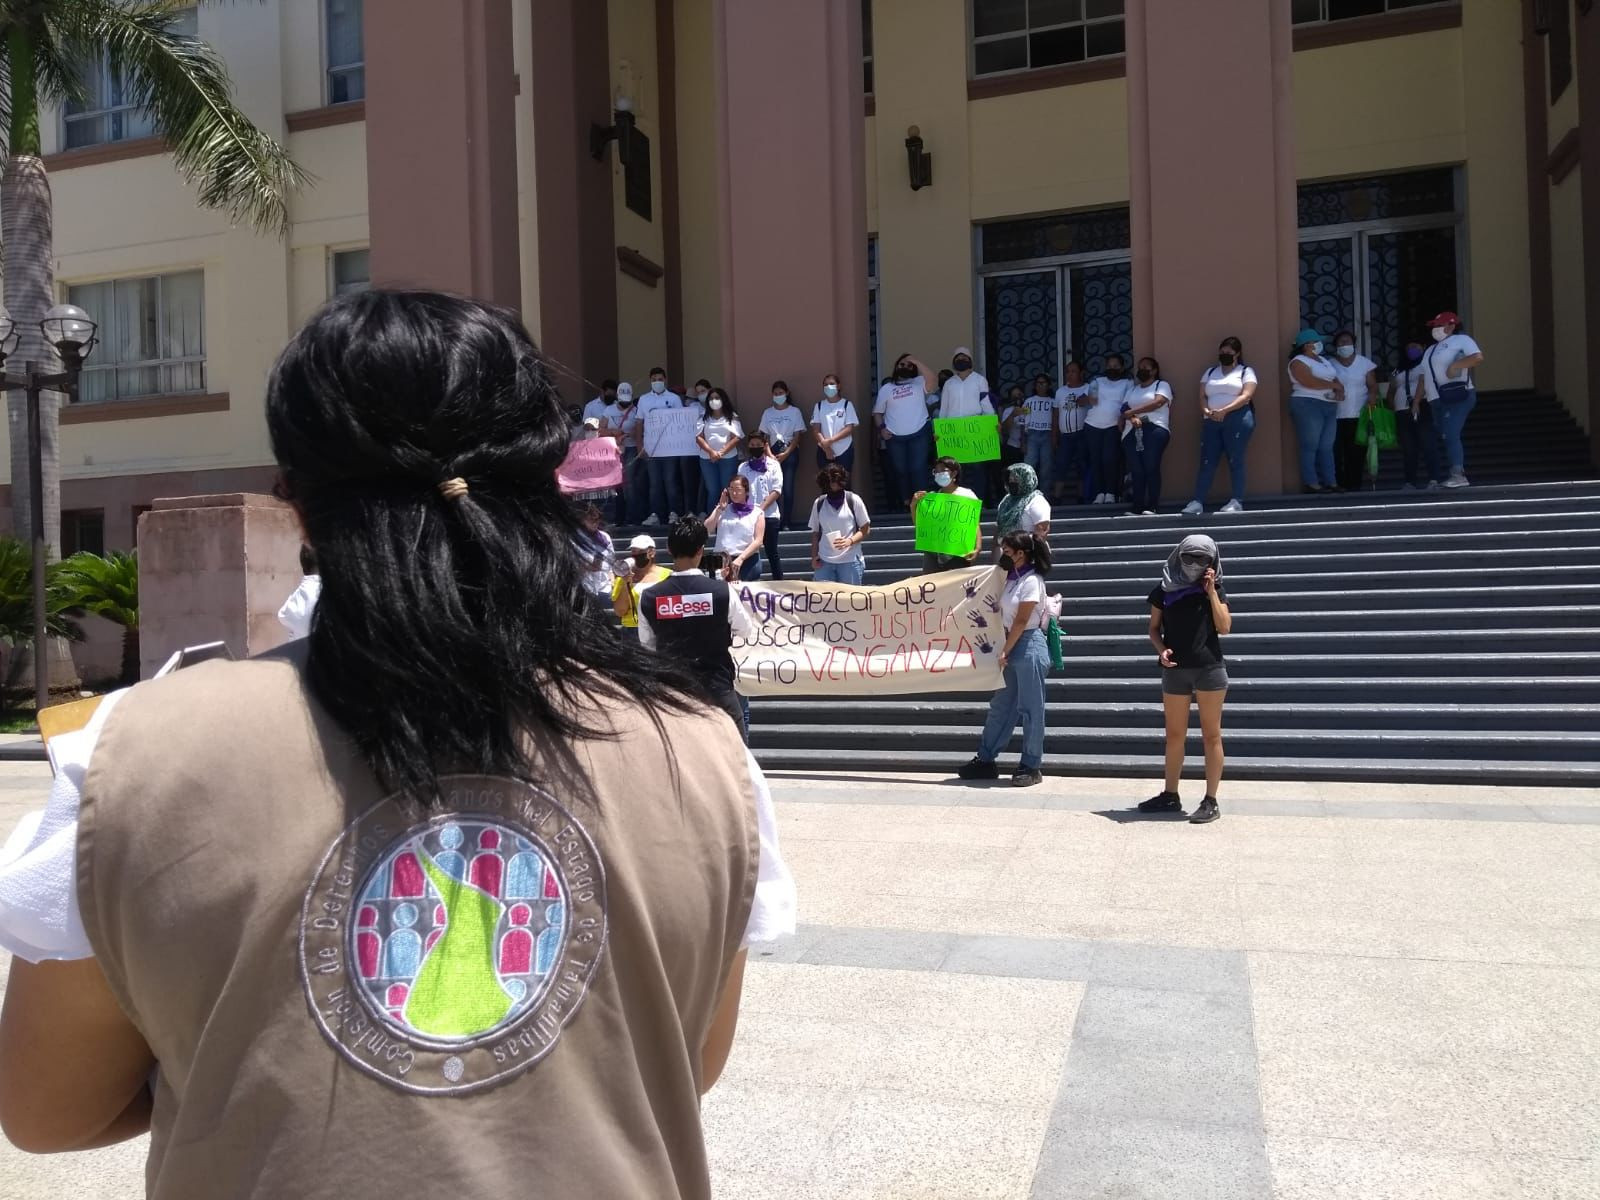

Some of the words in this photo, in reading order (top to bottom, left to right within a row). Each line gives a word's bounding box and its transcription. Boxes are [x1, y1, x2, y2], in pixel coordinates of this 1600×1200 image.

[658, 597, 711, 617] eleese
[740, 585, 887, 625] Agradezcan
[893, 581, 937, 612] que
[862, 605, 960, 641] JUSTICIA
[756, 659, 798, 685] no
[803, 634, 978, 683] VENGANZA
[517, 797, 554, 827] del
[552, 823, 595, 903] Estado
[576, 916, 602, 944] de
[311, 945, 341, 974] de
[494, 958, 593, 1064] Tamaulipas
